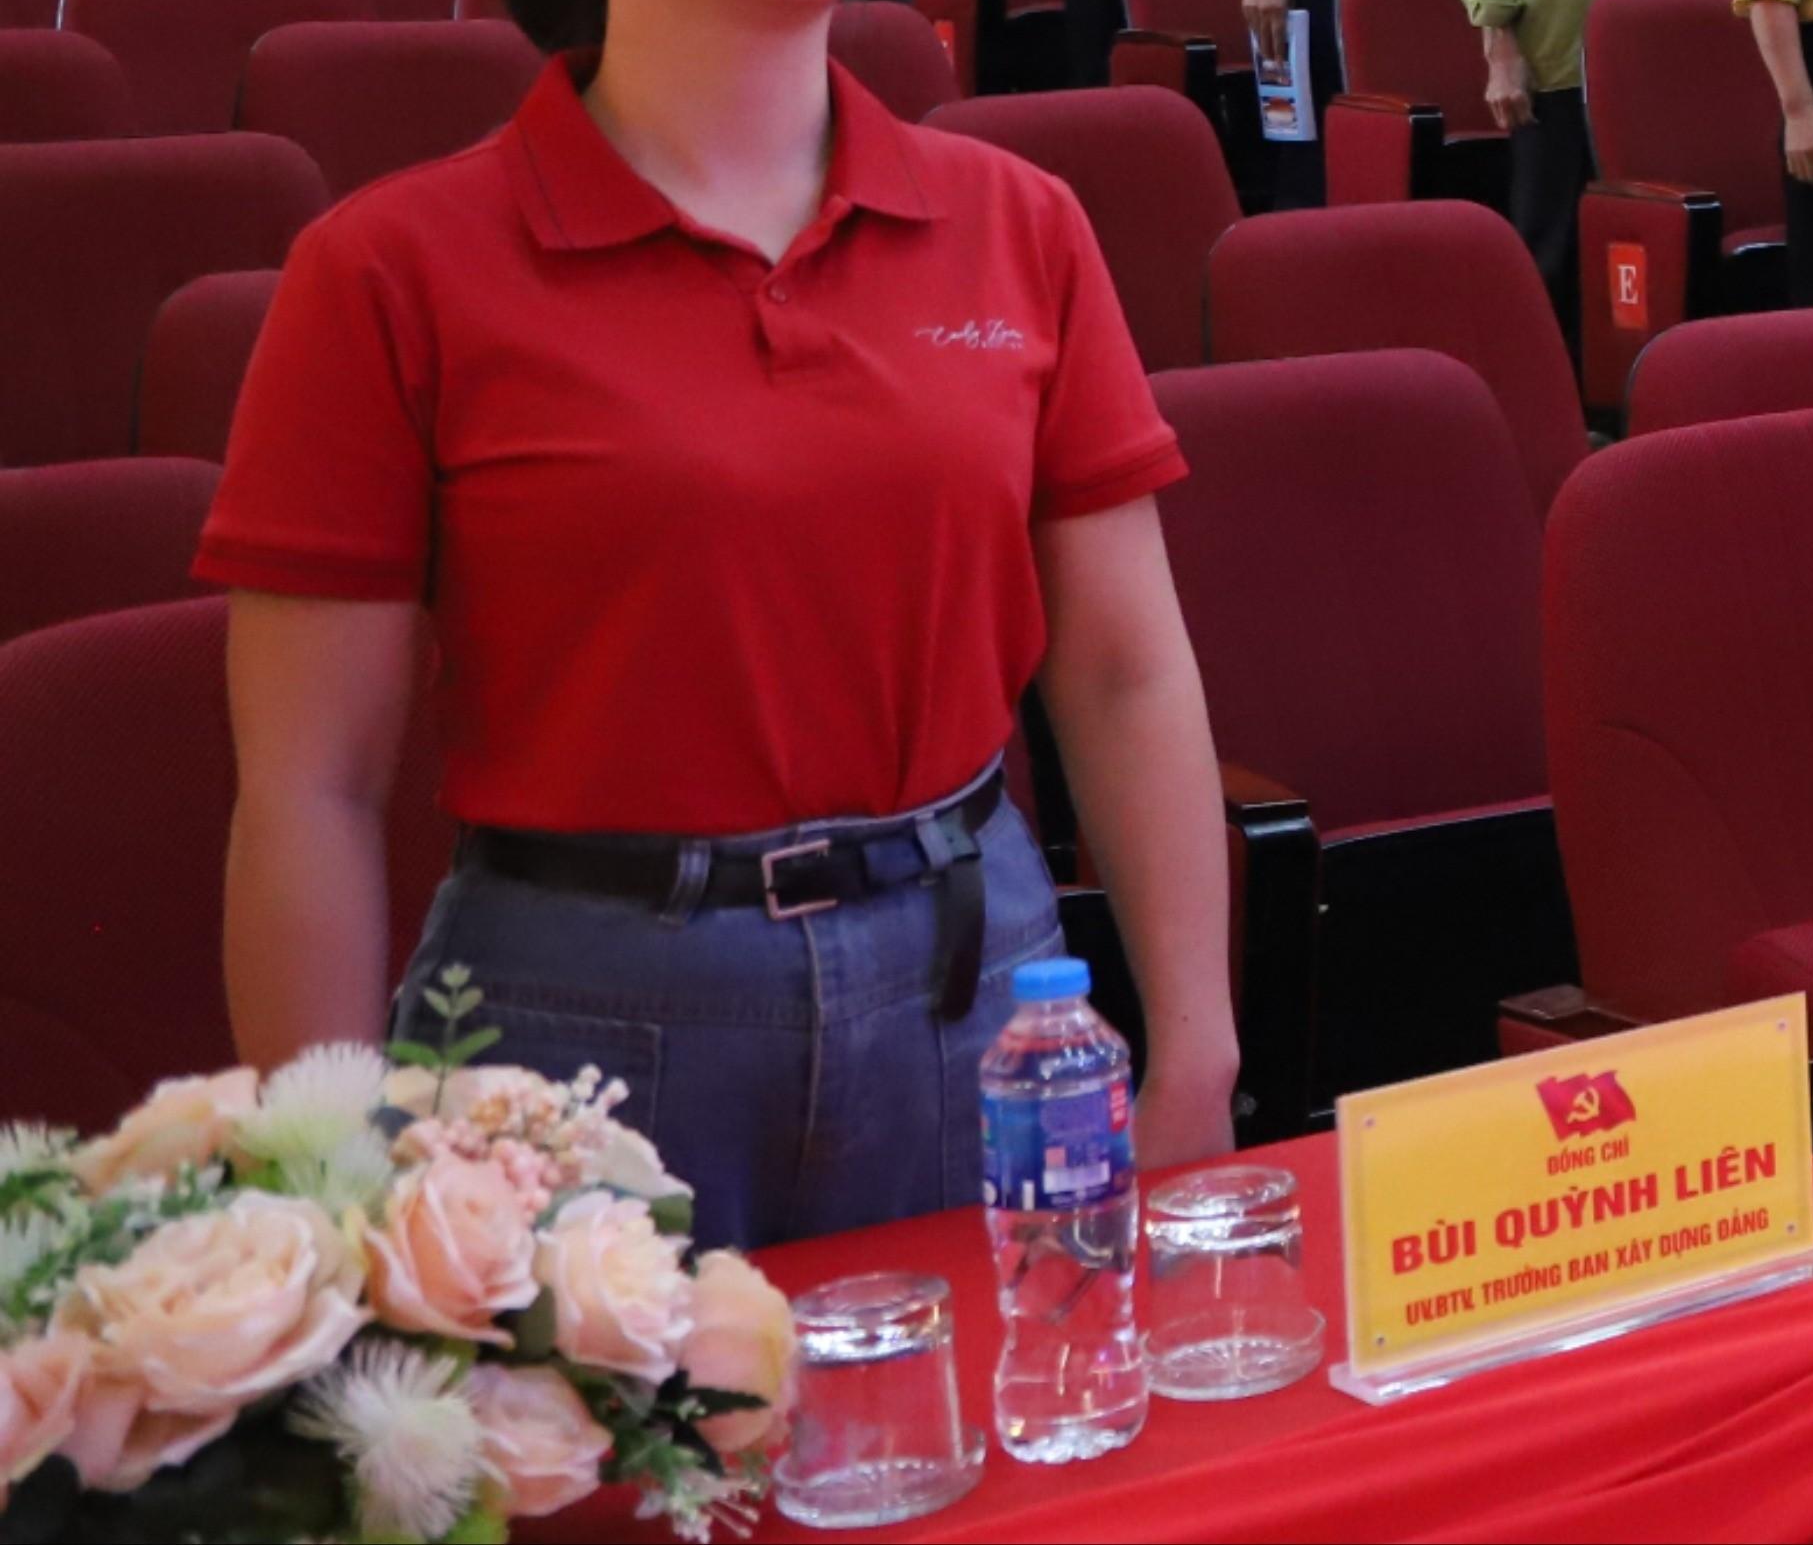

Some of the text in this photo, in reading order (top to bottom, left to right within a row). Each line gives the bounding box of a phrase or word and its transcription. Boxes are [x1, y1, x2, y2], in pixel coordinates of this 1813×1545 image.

[1616, 264, 1639, 304] E
[1600, 1136, 1630, 1166] CHÍ
[1391, 1142, 1777, 1275] BÙI QUỲNH LIÊN
[1482, 1262, 1563, 1306] TRƯỞNG
[1568, 1250, 1610, 1283] BAN
[1616, 1237, 1654, 1271] XÂY
[1659, 1222, 1712, 1260] DỰNG
[1718, 1205, 1770, 1242] ĐẢNG
